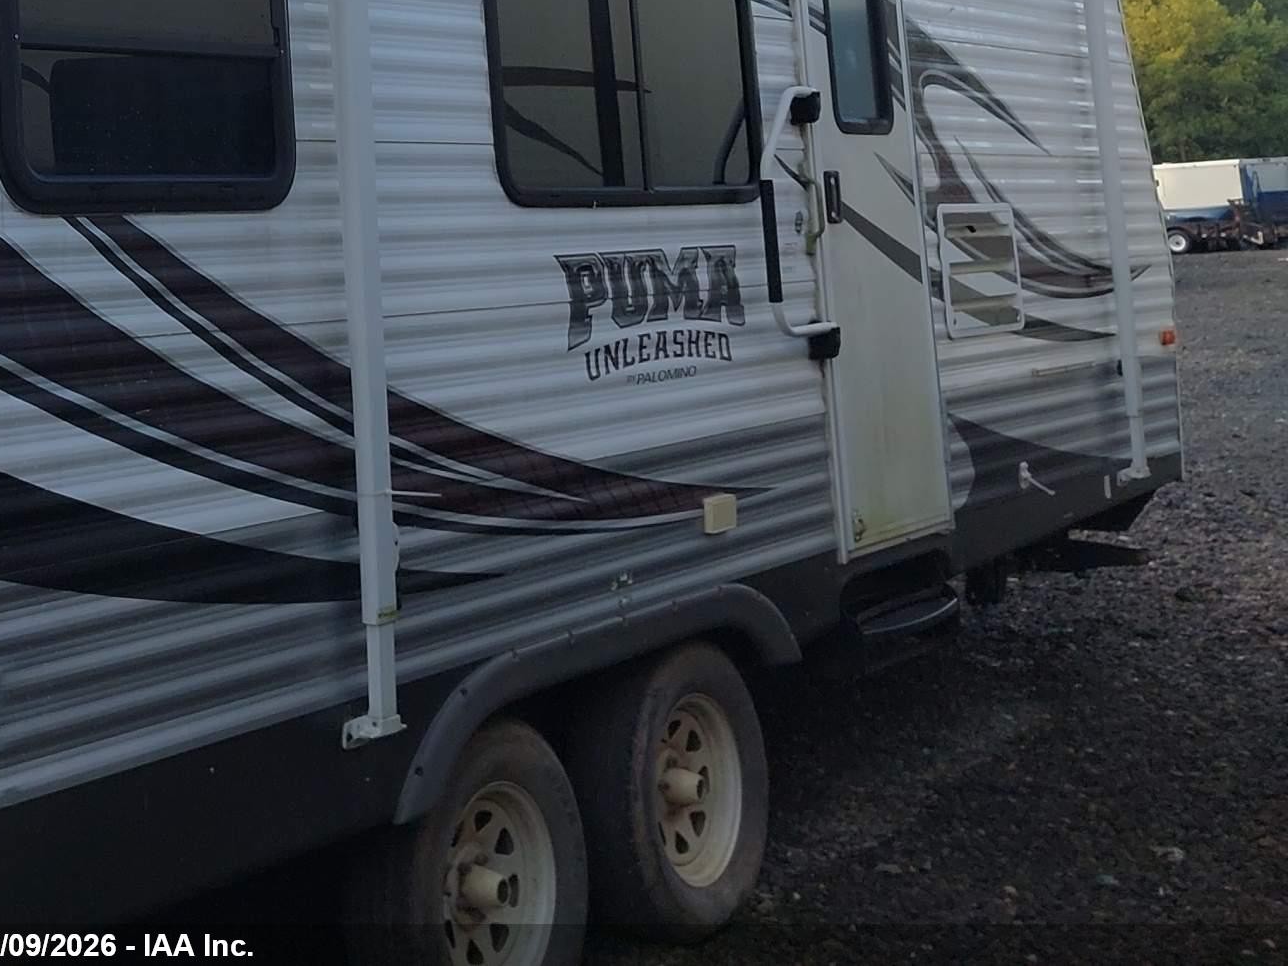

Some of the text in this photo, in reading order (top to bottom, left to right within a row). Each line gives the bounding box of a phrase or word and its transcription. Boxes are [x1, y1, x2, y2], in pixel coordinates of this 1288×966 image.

[553, 245, 746, 352] PUMA
[584, 329, 733, 382] UNLEASHED
[636, 365, 697, 385] PALOMINO
